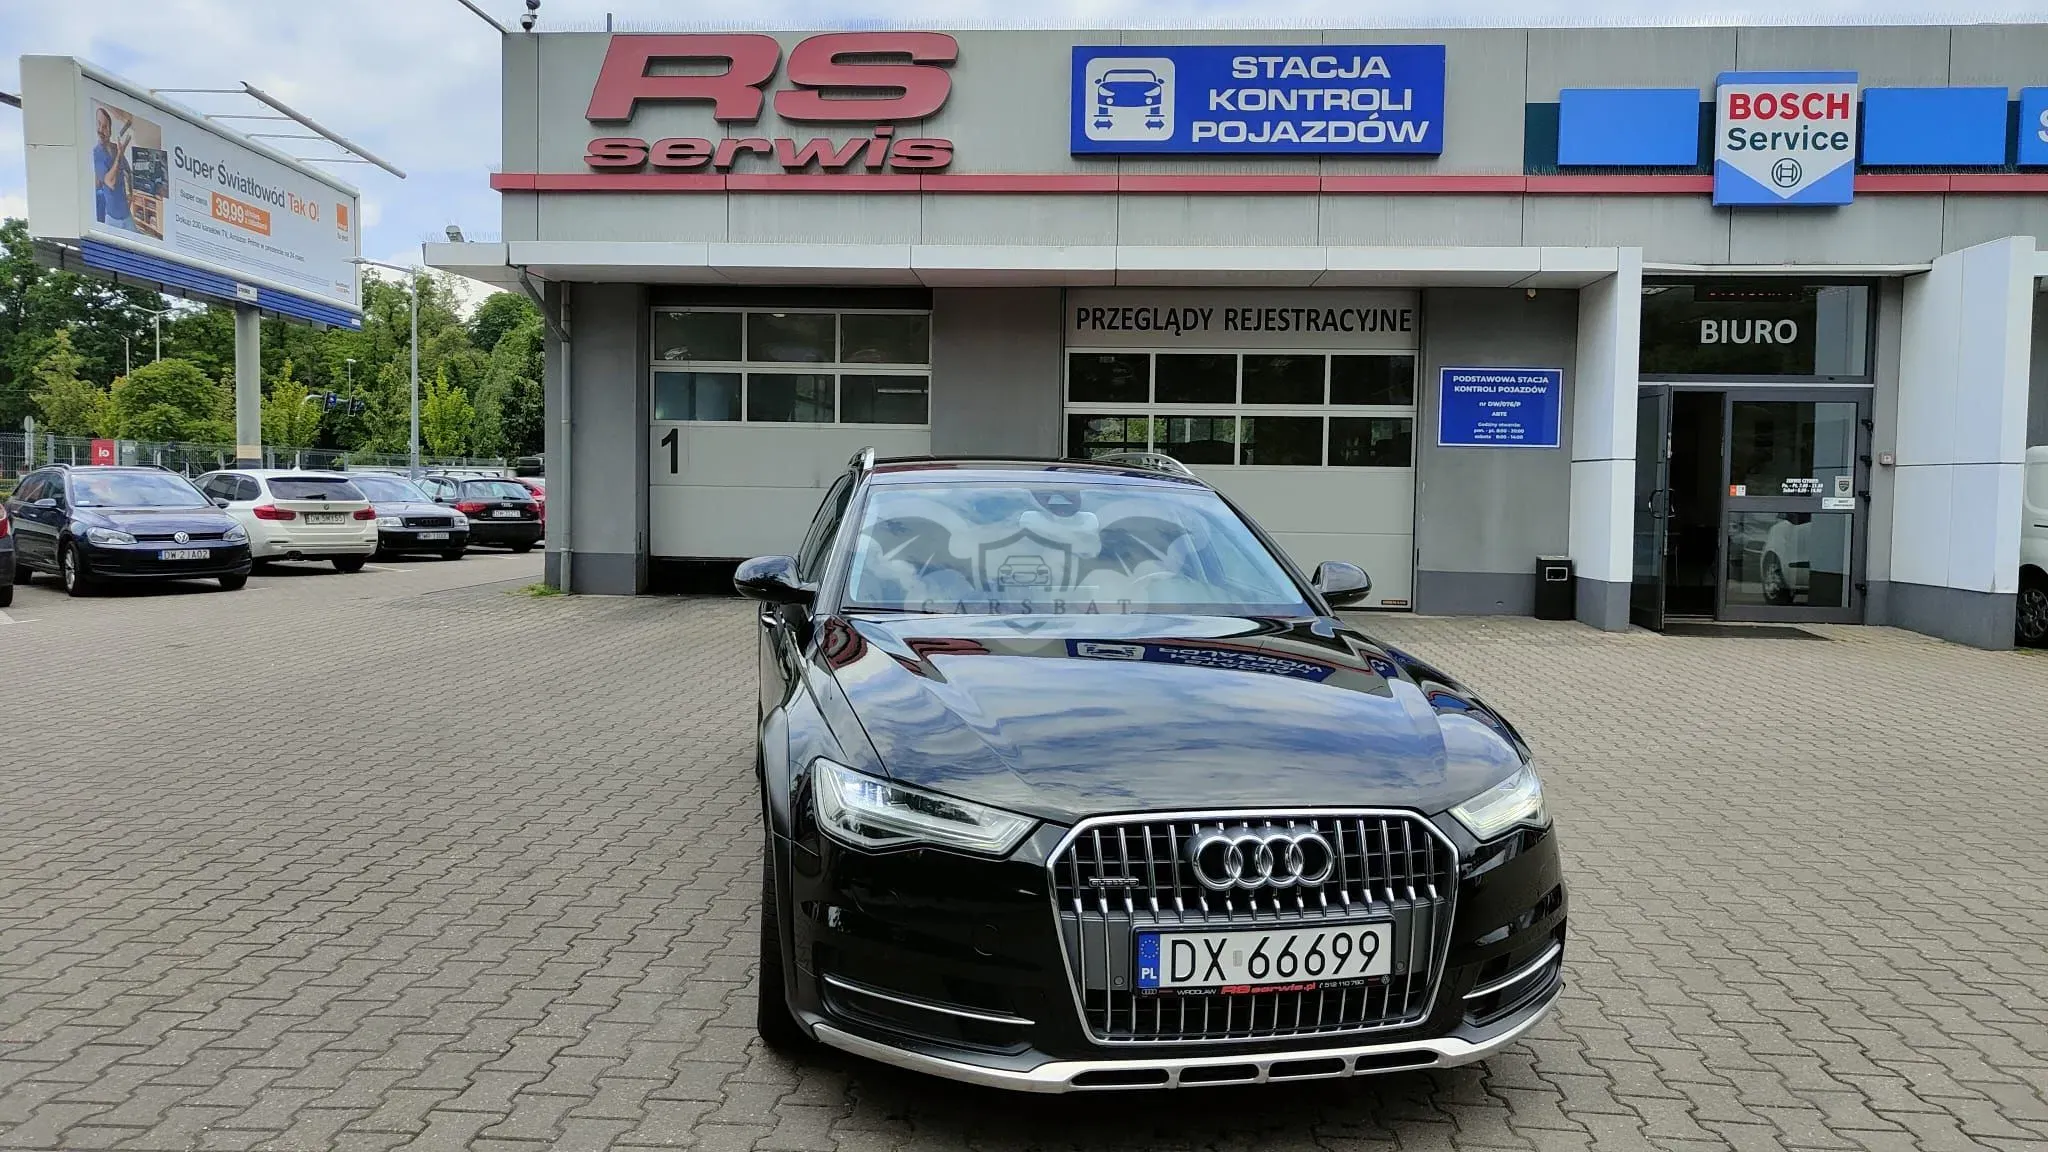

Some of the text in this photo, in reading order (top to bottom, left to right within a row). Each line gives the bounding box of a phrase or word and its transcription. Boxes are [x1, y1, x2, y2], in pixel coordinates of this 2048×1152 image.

[586, 32, 959, 122] RS
[1232, 56, 1391, 79] STACJA
[1209, 88, 1412, 111] KONTROLI
[1729, 92, 1849, 120] BOSCH
[1192, 112, 1429, 143] POJAZDÓW
[1727, 124, 1849, 151] Service
[584, 125, 954, 172] serwis
[174, 146, 320, 222] Super Światłowód Tak O!
[215, 197, 245, 223] 39,99
[1076, 307, 1413, 336] PRZEGLĄDY REJESTRACYJNE
[1701, 319, 1798, 344] BIURO
[1453, 375, 1549, 384] PODSTAWOWA STACJA
[1454, 384, 1547, 394] KONTROLI POJAZDÓW
[661, 428, 679, 474] 1
[164, 551, 177, 559] DW
[1171, 930, 1380, 982] DX 66699
[1141, 966, 1158, 980] PL
